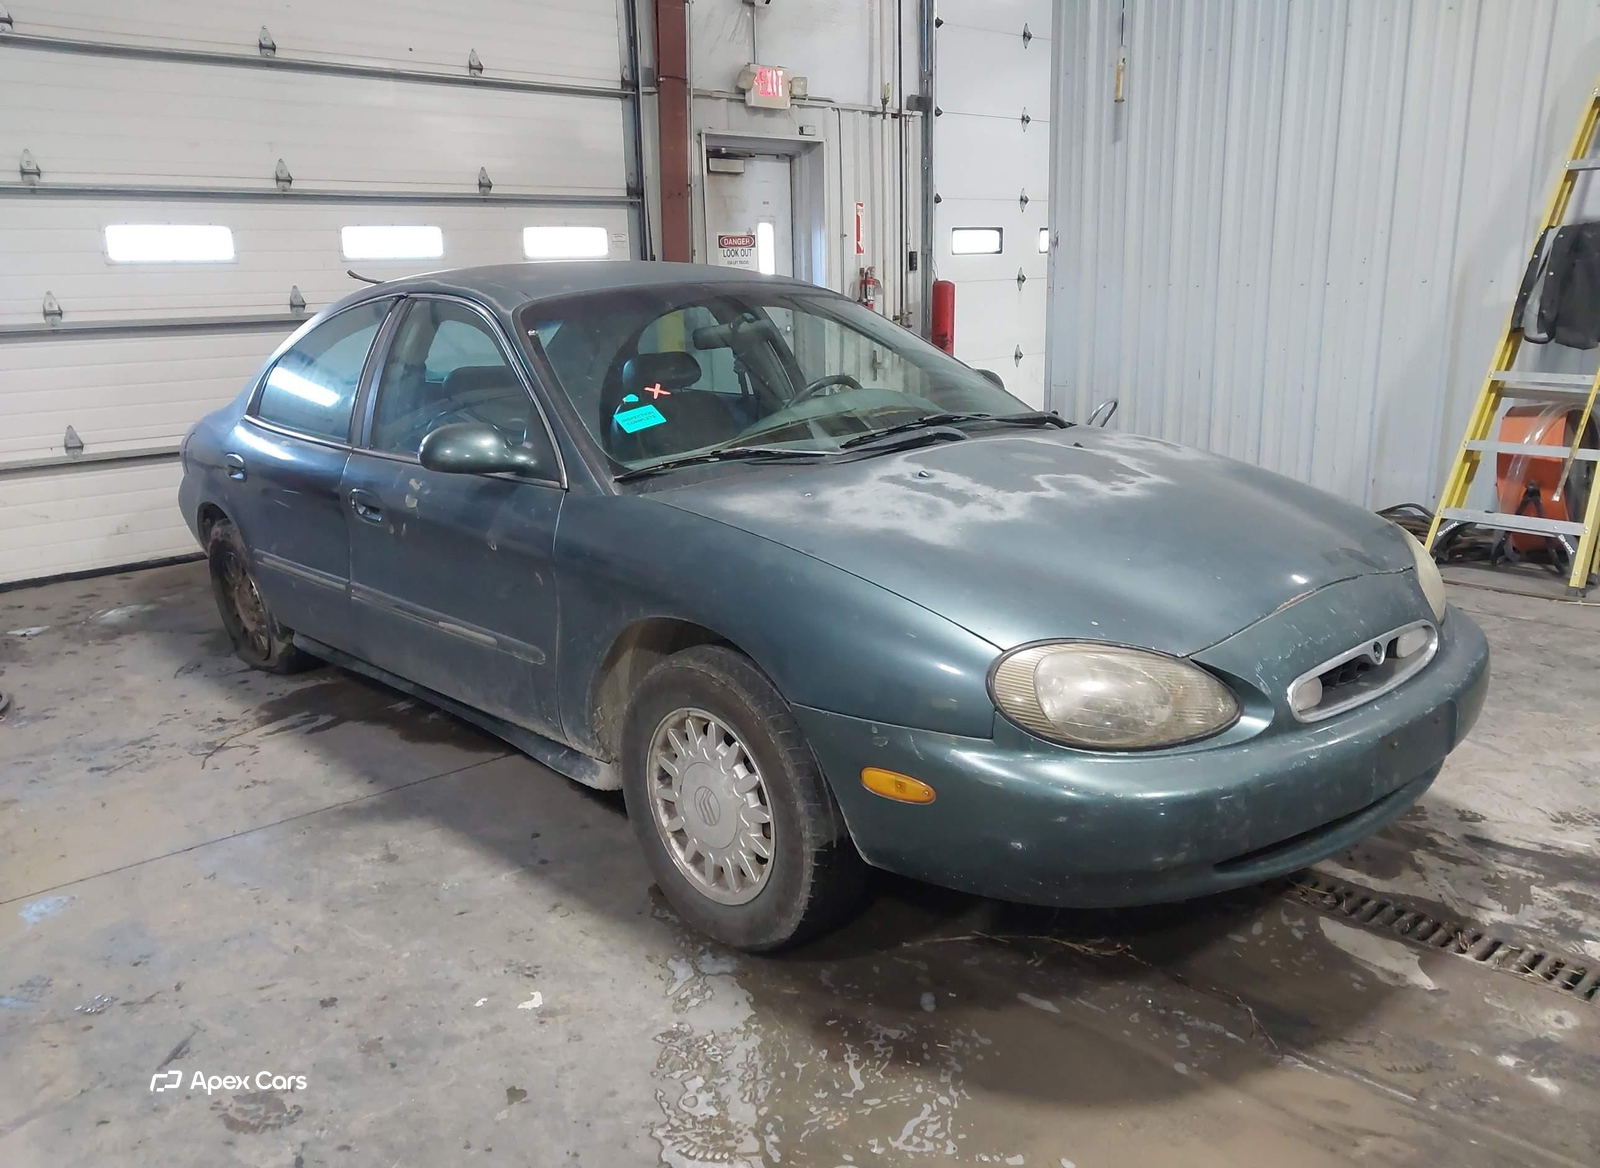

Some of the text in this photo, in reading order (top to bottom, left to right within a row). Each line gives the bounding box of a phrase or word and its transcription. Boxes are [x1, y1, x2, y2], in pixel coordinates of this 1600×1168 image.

[758, 67, 784, 97] EXIT
[723, 237, 751, 246] DANGER
[723, 248, 752, 258] LOOK OUT
